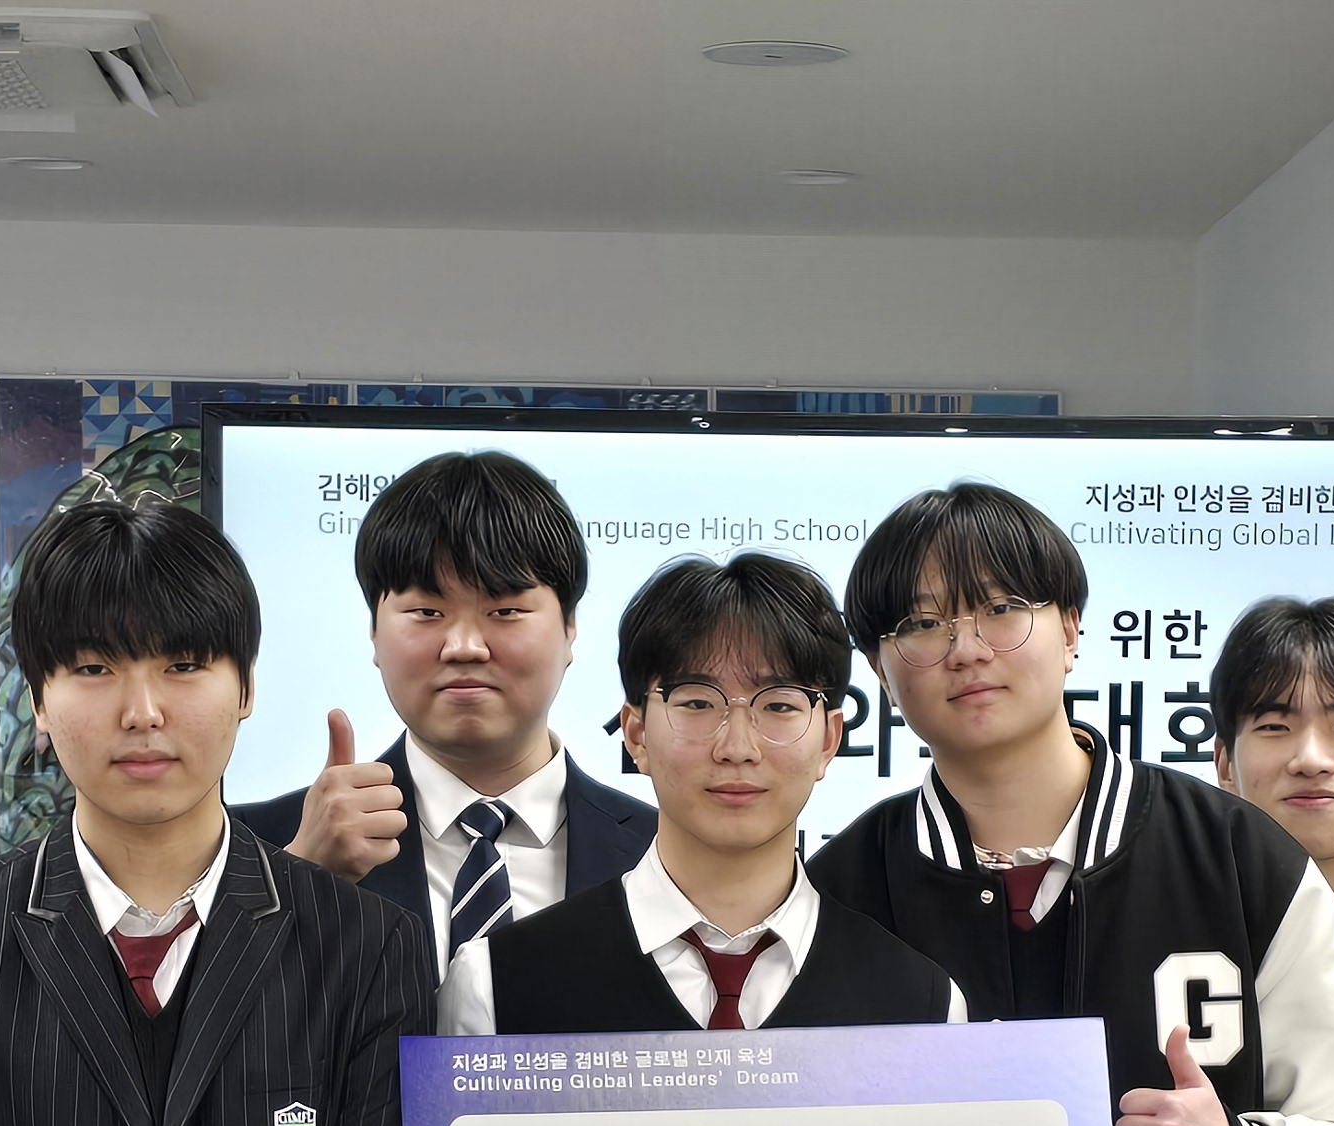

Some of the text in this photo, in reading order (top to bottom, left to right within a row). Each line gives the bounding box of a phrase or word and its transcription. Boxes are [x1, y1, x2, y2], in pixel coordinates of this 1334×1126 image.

[1086, 484, 1165, 513] 지성과
[1174, 484, 1252, 514] 인성을
[581, 517, 867, 546] nguage High School
[1070, 521, 1222, 551] Cultivating
[1233, 523, 1318, 546] Global
[1110, 608, 1208, 660] 위한
[1153, 951, 1244, 1066] G
[452, 1047, 773, 1072] 지성과 인성을 겸비한 글로벌 인재 육성
[453, 1074, 563, 1092] Cultivating
[570, 1073, 633, 1089] Global
[737, 1069, 799, 1085] Dream
